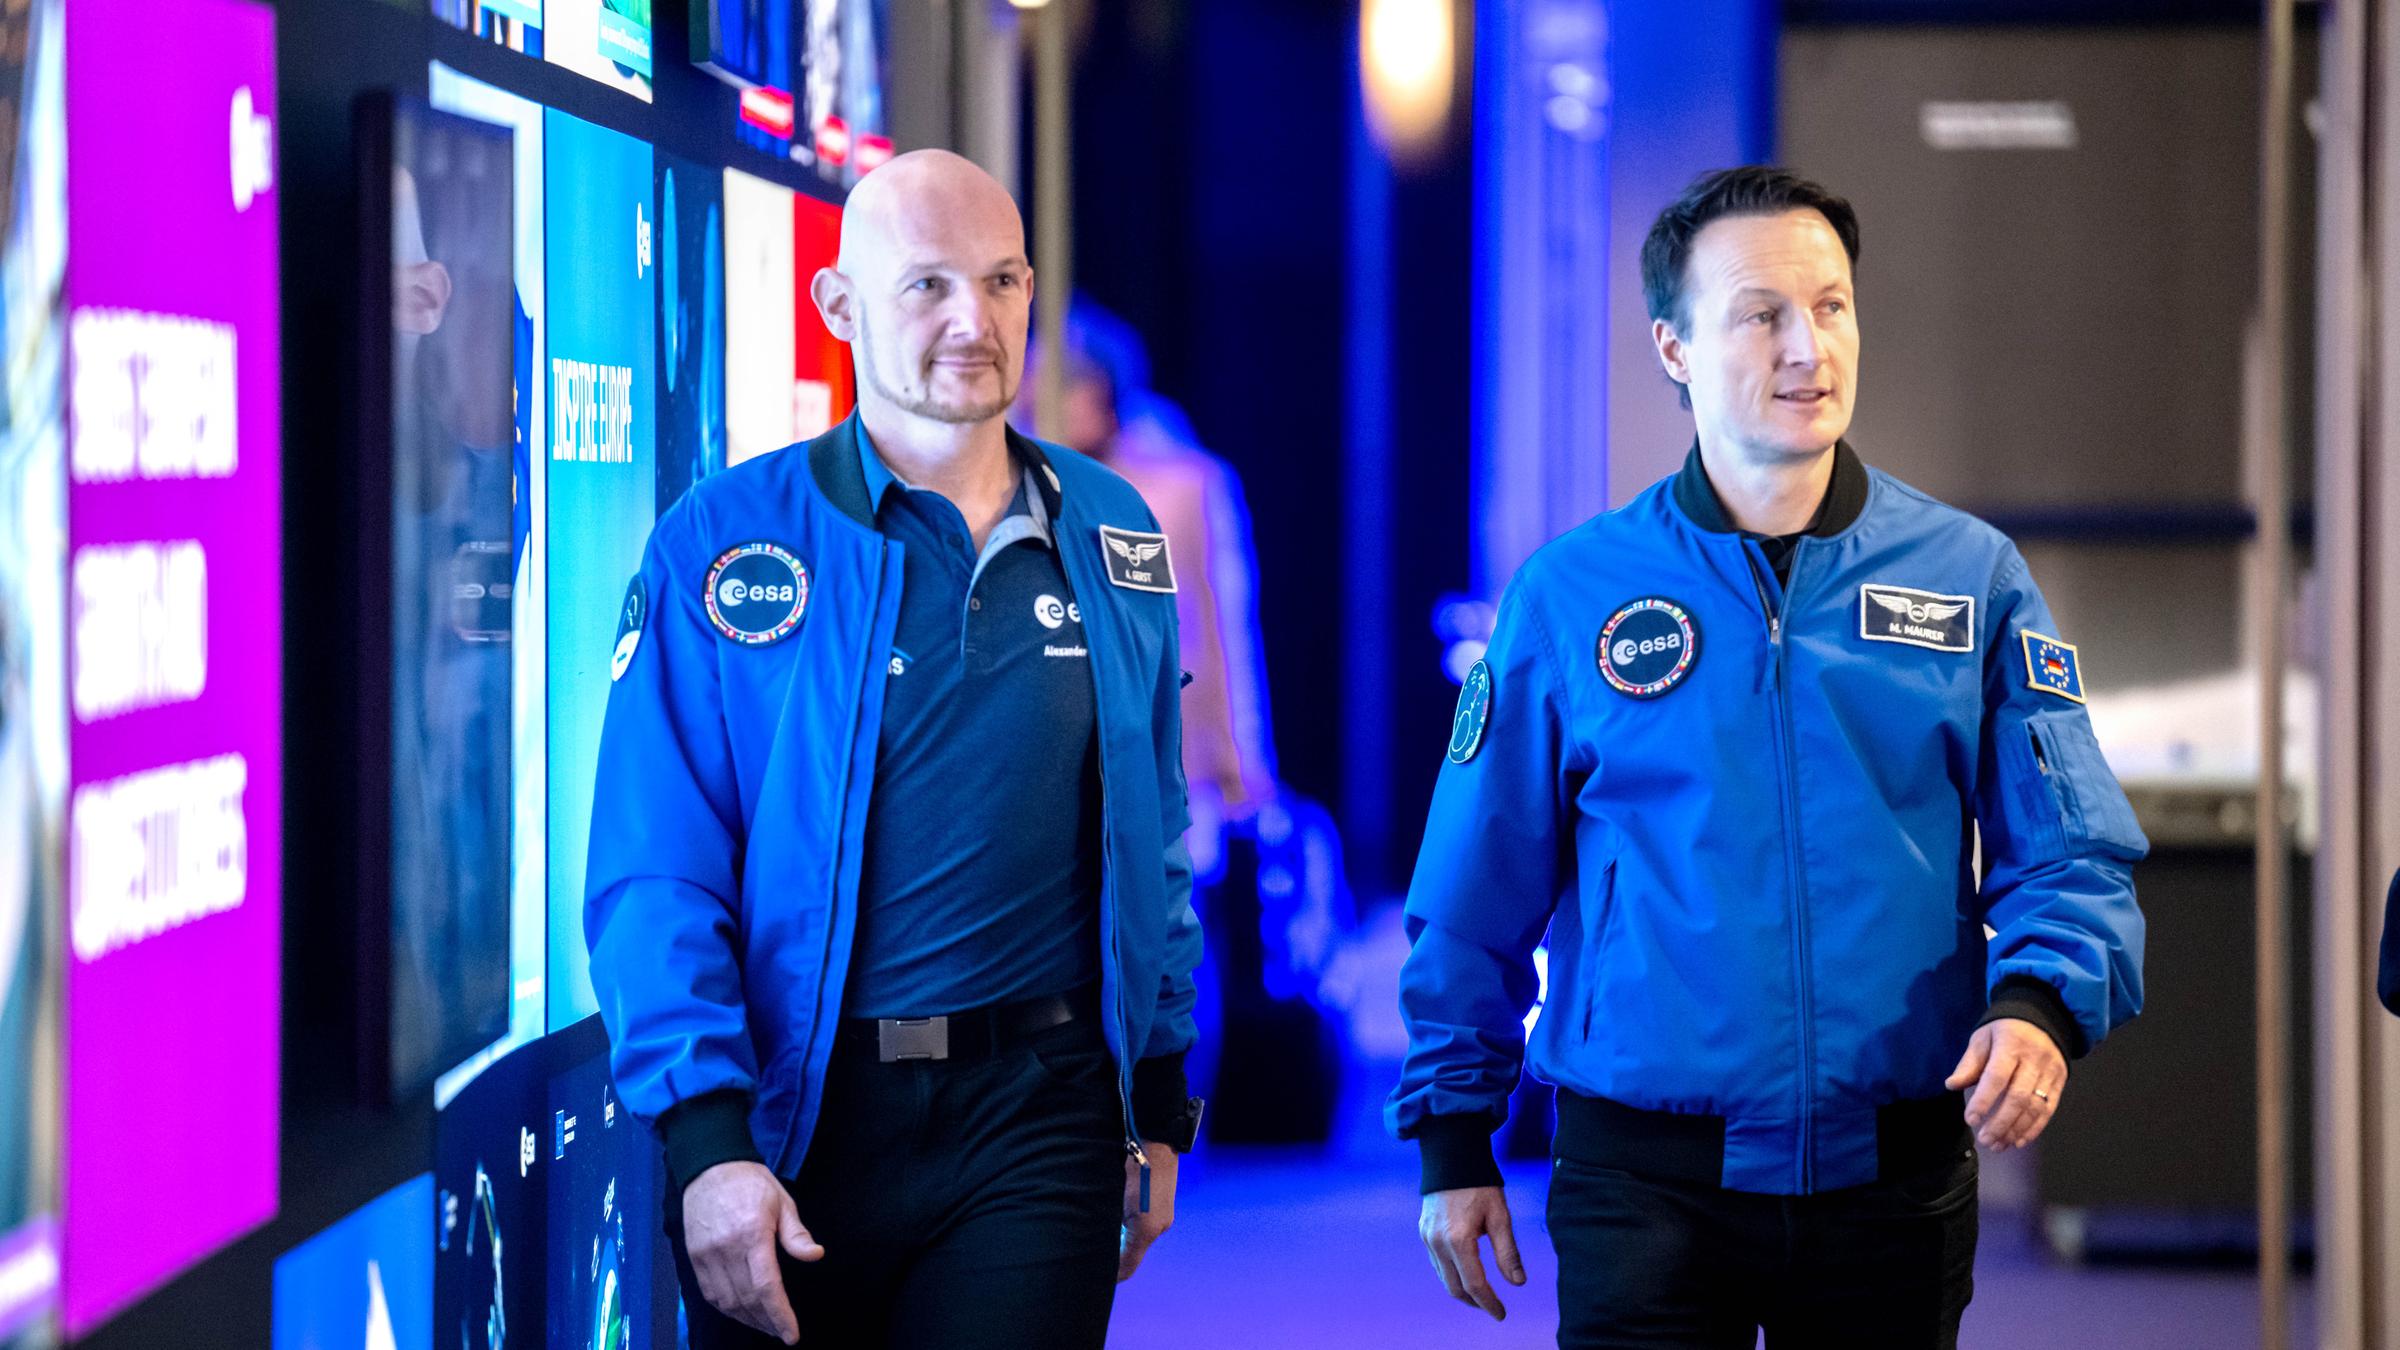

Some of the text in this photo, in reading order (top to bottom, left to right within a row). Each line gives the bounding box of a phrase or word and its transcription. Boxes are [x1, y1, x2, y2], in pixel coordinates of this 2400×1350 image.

[552, 357, 633, 464] INSPIRE EUROPE
[749, 584, 794, 602] esa
[1639, 632, 1680, 655] esa
[1889, 622, 1945, 643] M. MAURER
